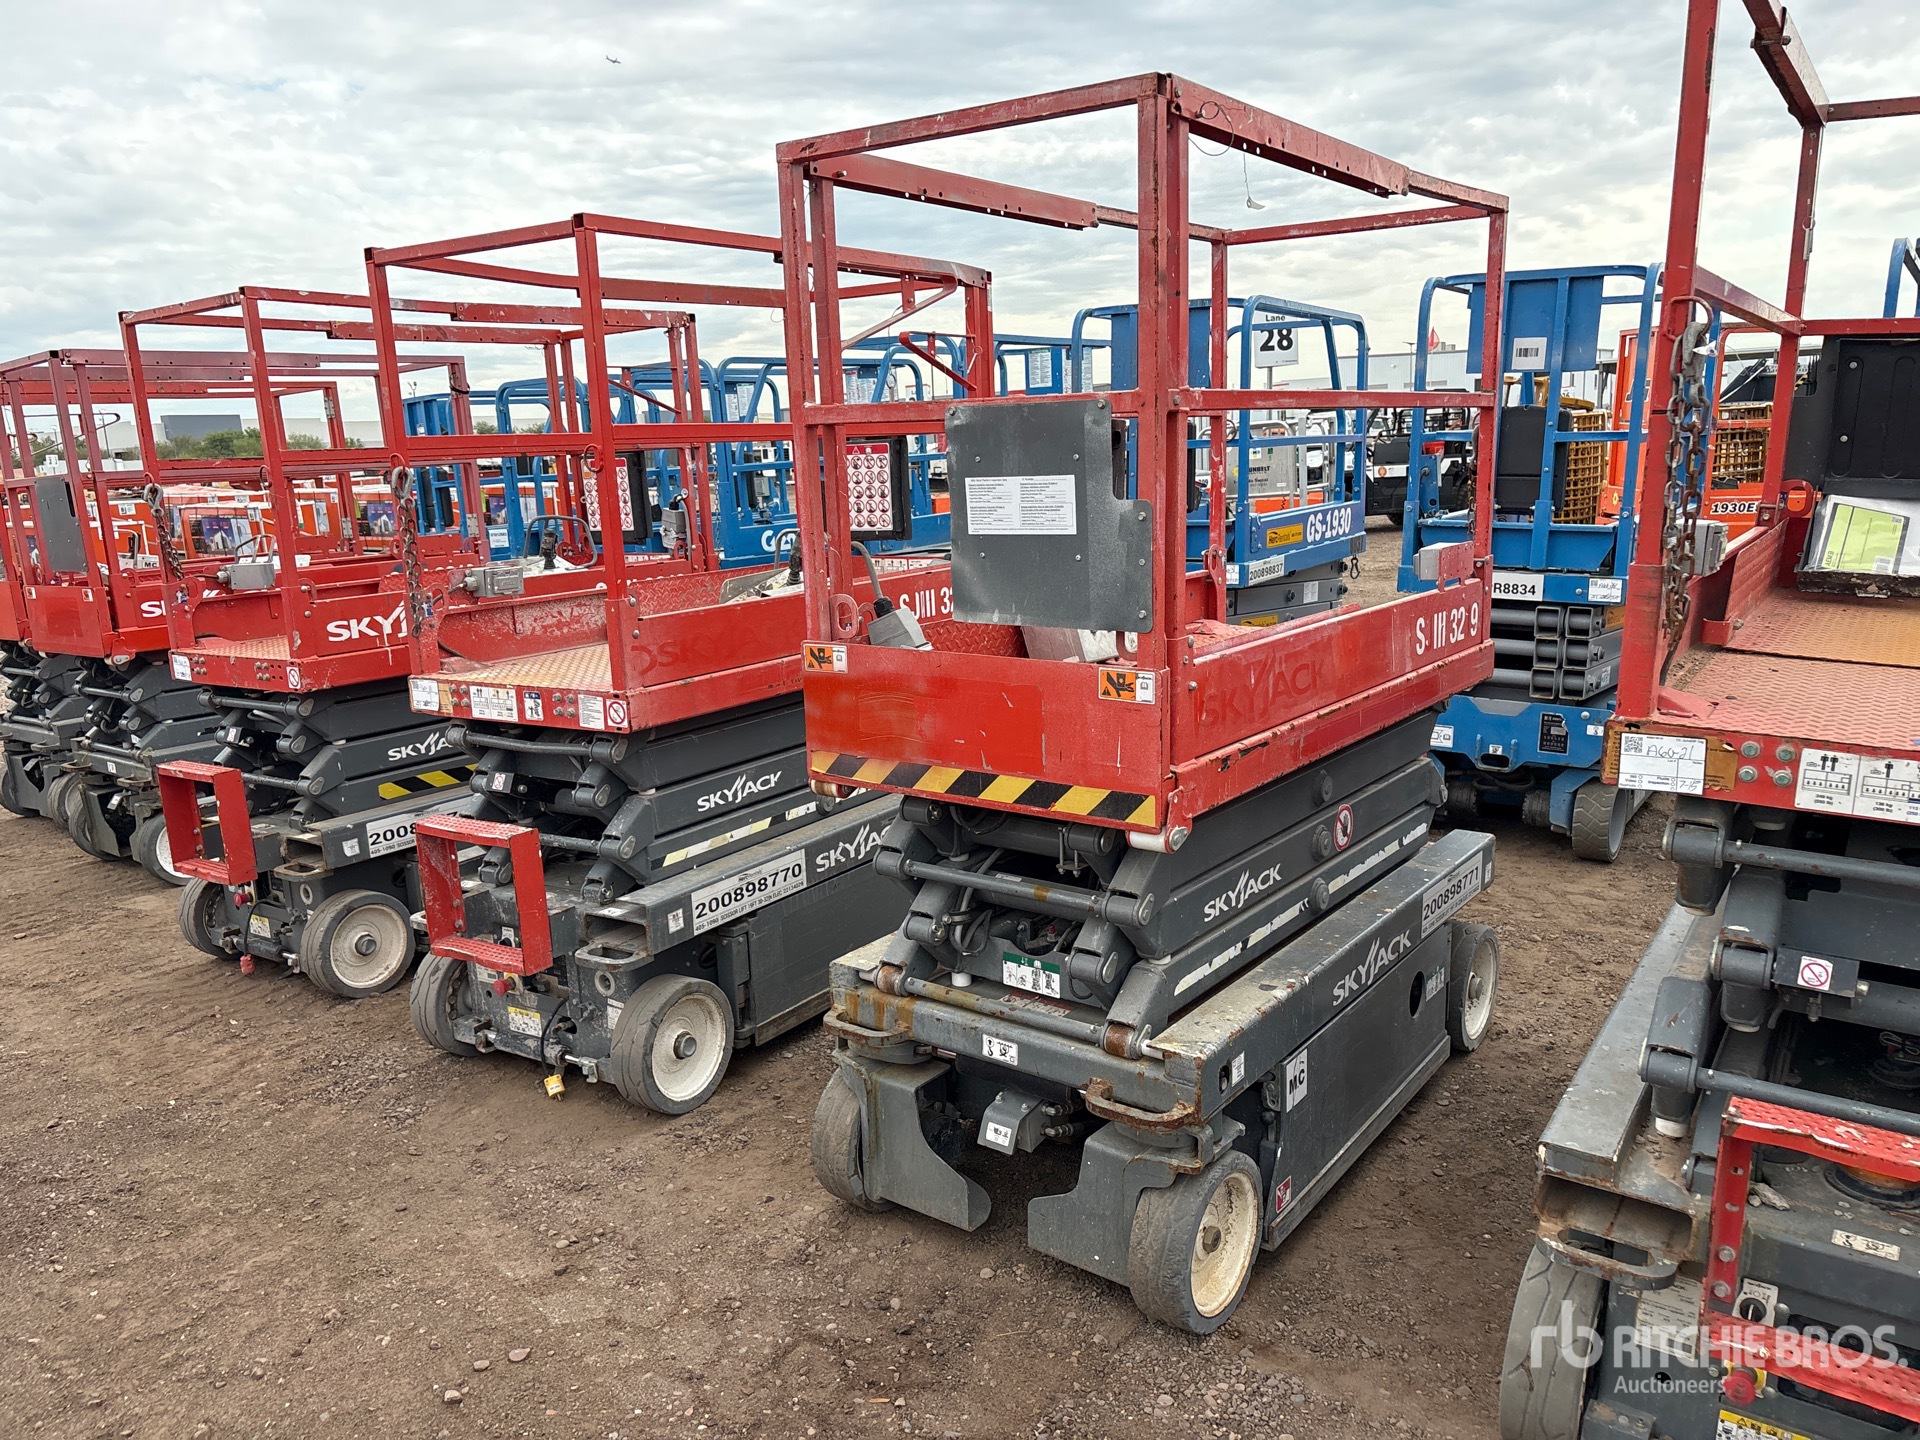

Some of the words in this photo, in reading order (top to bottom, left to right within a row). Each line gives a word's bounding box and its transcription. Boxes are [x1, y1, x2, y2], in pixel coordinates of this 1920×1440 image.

[1265, 314, 1286, 322] Lane
[1260, 327, 1294, 352] 28
[1248, 465, 1271, 473] UNBELT
[1711, 502, 1758, 514] 1930E
[1306, 507, 1352, 543] GS-1930
[1249, 562, 1284, 581] 200898837
[1491, 582, 1537, 596] R8834
[697, 771, 782, 812] SKYJACK
[694, 863, 802, 919] 200898770
[1203, 863, 1282, 922] SKYJACK
[1423, 866, 1479, 921] 200898771
[1333, 930, 1412, 1006] SKYJACK
